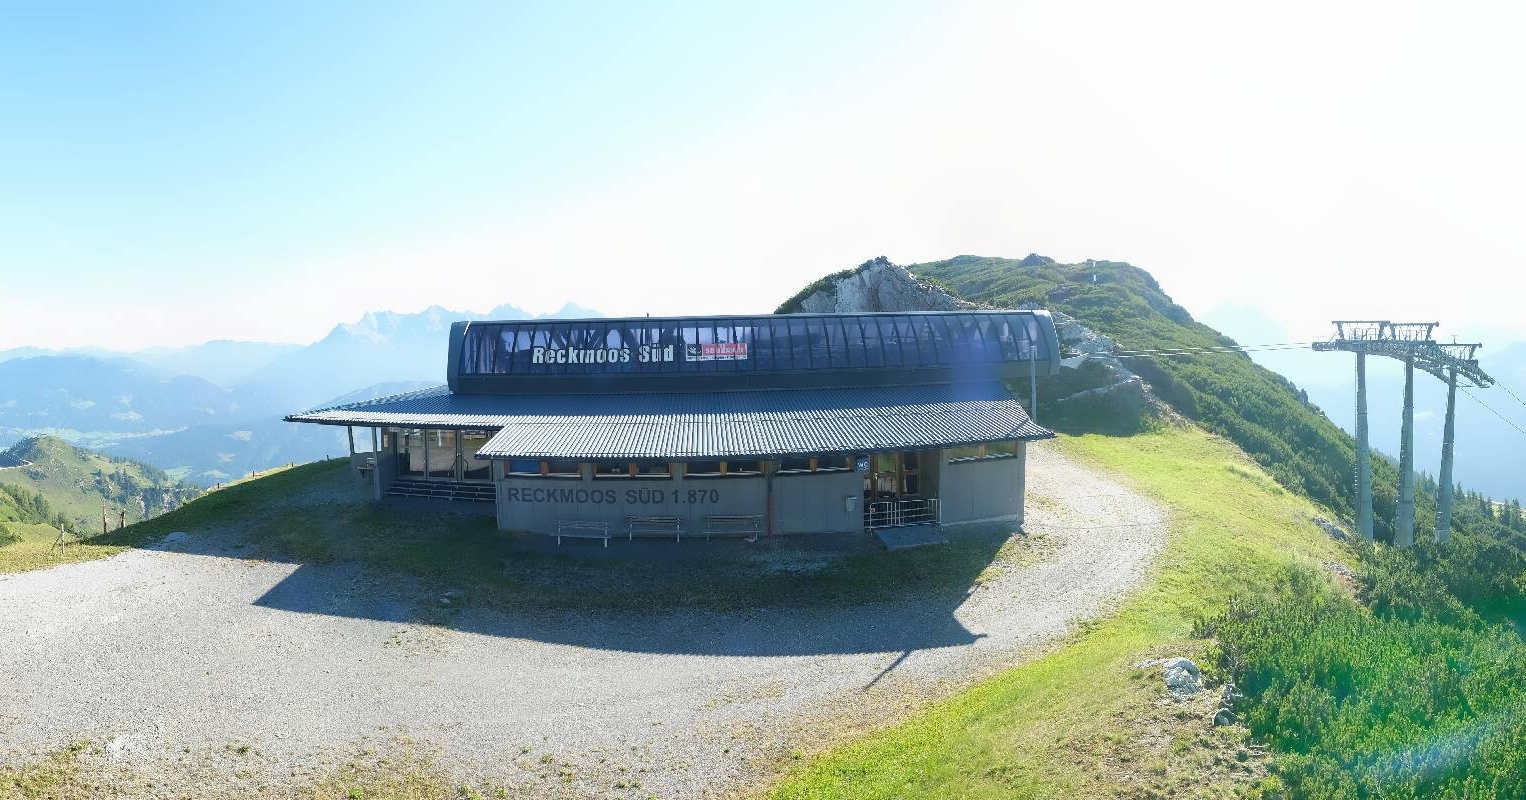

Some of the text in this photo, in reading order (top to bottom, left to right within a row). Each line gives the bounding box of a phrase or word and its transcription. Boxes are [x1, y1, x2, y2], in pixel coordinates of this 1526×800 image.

[532, 344, 675, 364] Reckmoos Süd
[507, 487, 720, 504] RECKMOOS SÜD 1.870
